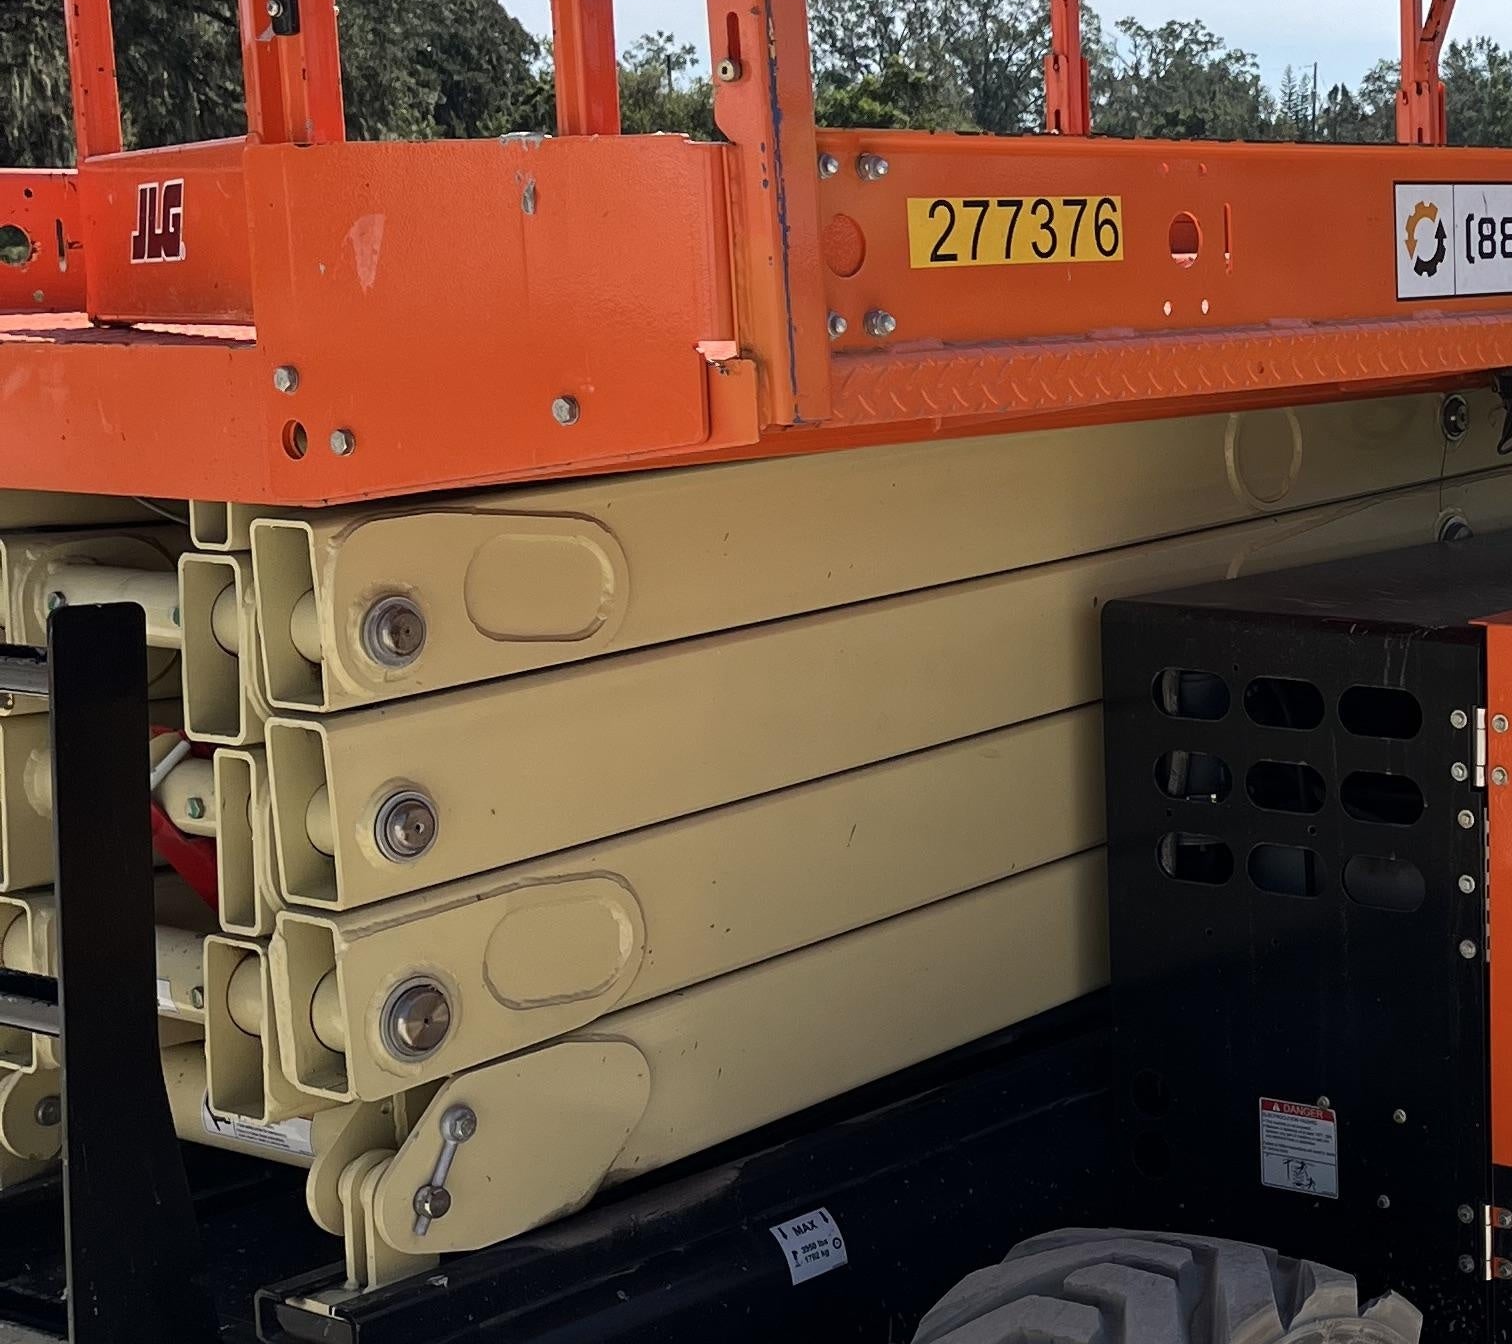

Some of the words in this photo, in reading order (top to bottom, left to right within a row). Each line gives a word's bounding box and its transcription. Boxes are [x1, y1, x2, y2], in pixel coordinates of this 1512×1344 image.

[130, 178, 185, 264] JLG
[928, 197, 1119, 263] 277376
[1283, 1103, 1324, 1119] DANGER
[792, 1220, 818, 1236] MAX
